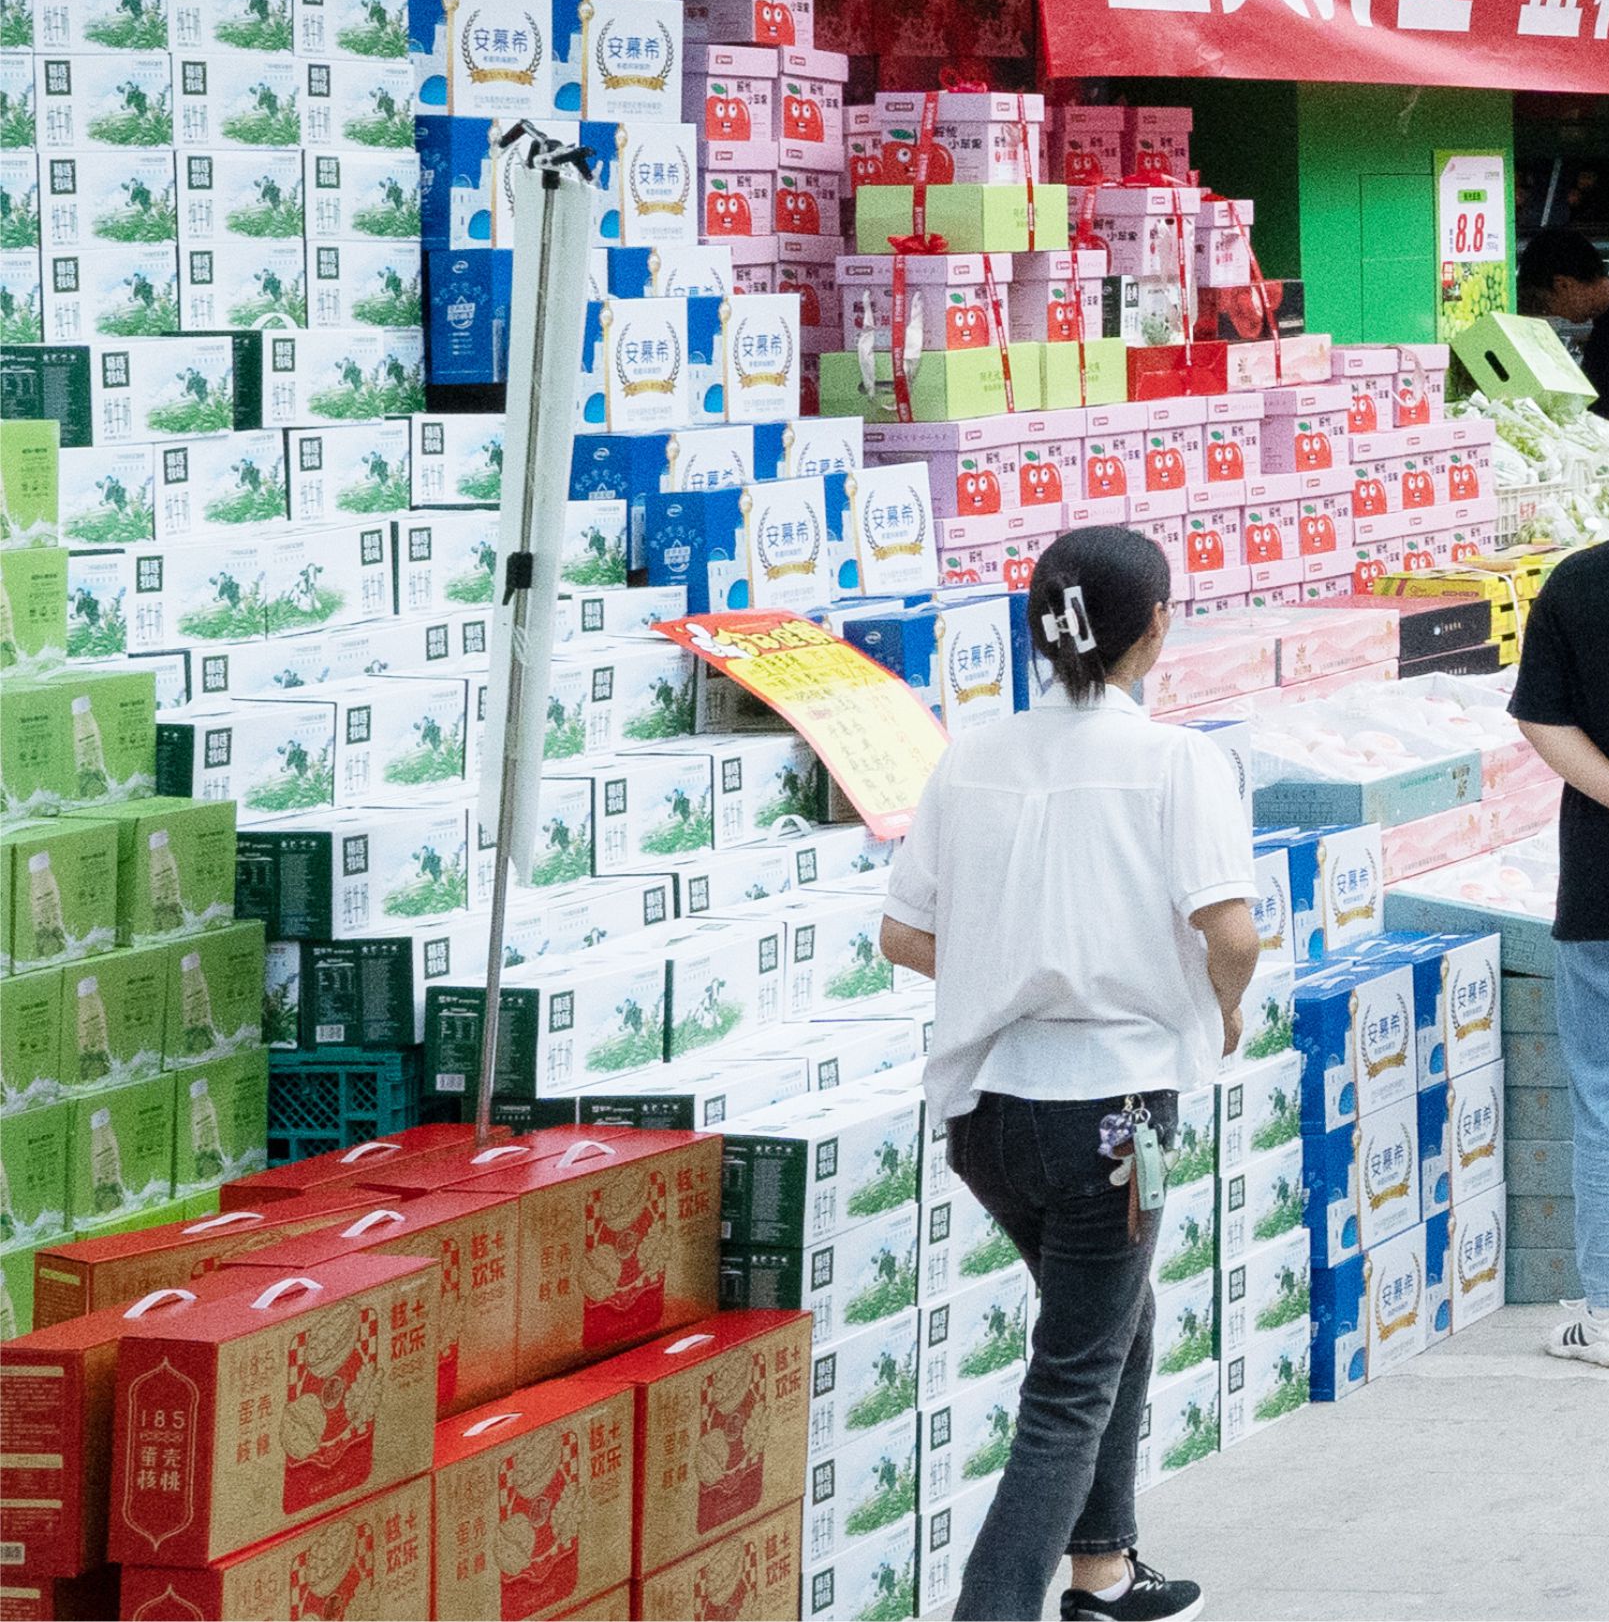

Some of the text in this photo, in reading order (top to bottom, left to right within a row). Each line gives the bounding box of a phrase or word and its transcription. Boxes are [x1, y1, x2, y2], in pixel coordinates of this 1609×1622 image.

[474, 28, 528, 54] 安慕希
[607, 35, 660, 62] 安慕希
[637, 161, 681, 186] 安慕希
[1455, 212, 1486, 254] 8.8
[625, 339, 669, 365] 安慕希
[742, 333, 782, 359] 安慕希
[872, 500, 915, 530] 安慕希
[766, 521, 810, 549] 安慕希
[957, 640, 996, 673] 安慕希
[1336, 863, 1370, 896] 安慕希
[1457, 978, 1489, 1012] 安慕希
[1366, 1010, 1404, 1046] 安慕希
[1462, 1105, 1495, 1137] 安慕希
[1370, 1144, 1405, 1180] 安慕希
[1463, 1231, 1496, 1263] 安慕希
[1381, 1269, 1415, 1308] 安慕希
[140, 1409, 187, 1430] 185
[140, 1447, 182, 1468] 蛋壳
[137, 1469, 182, 1493] 核桃
